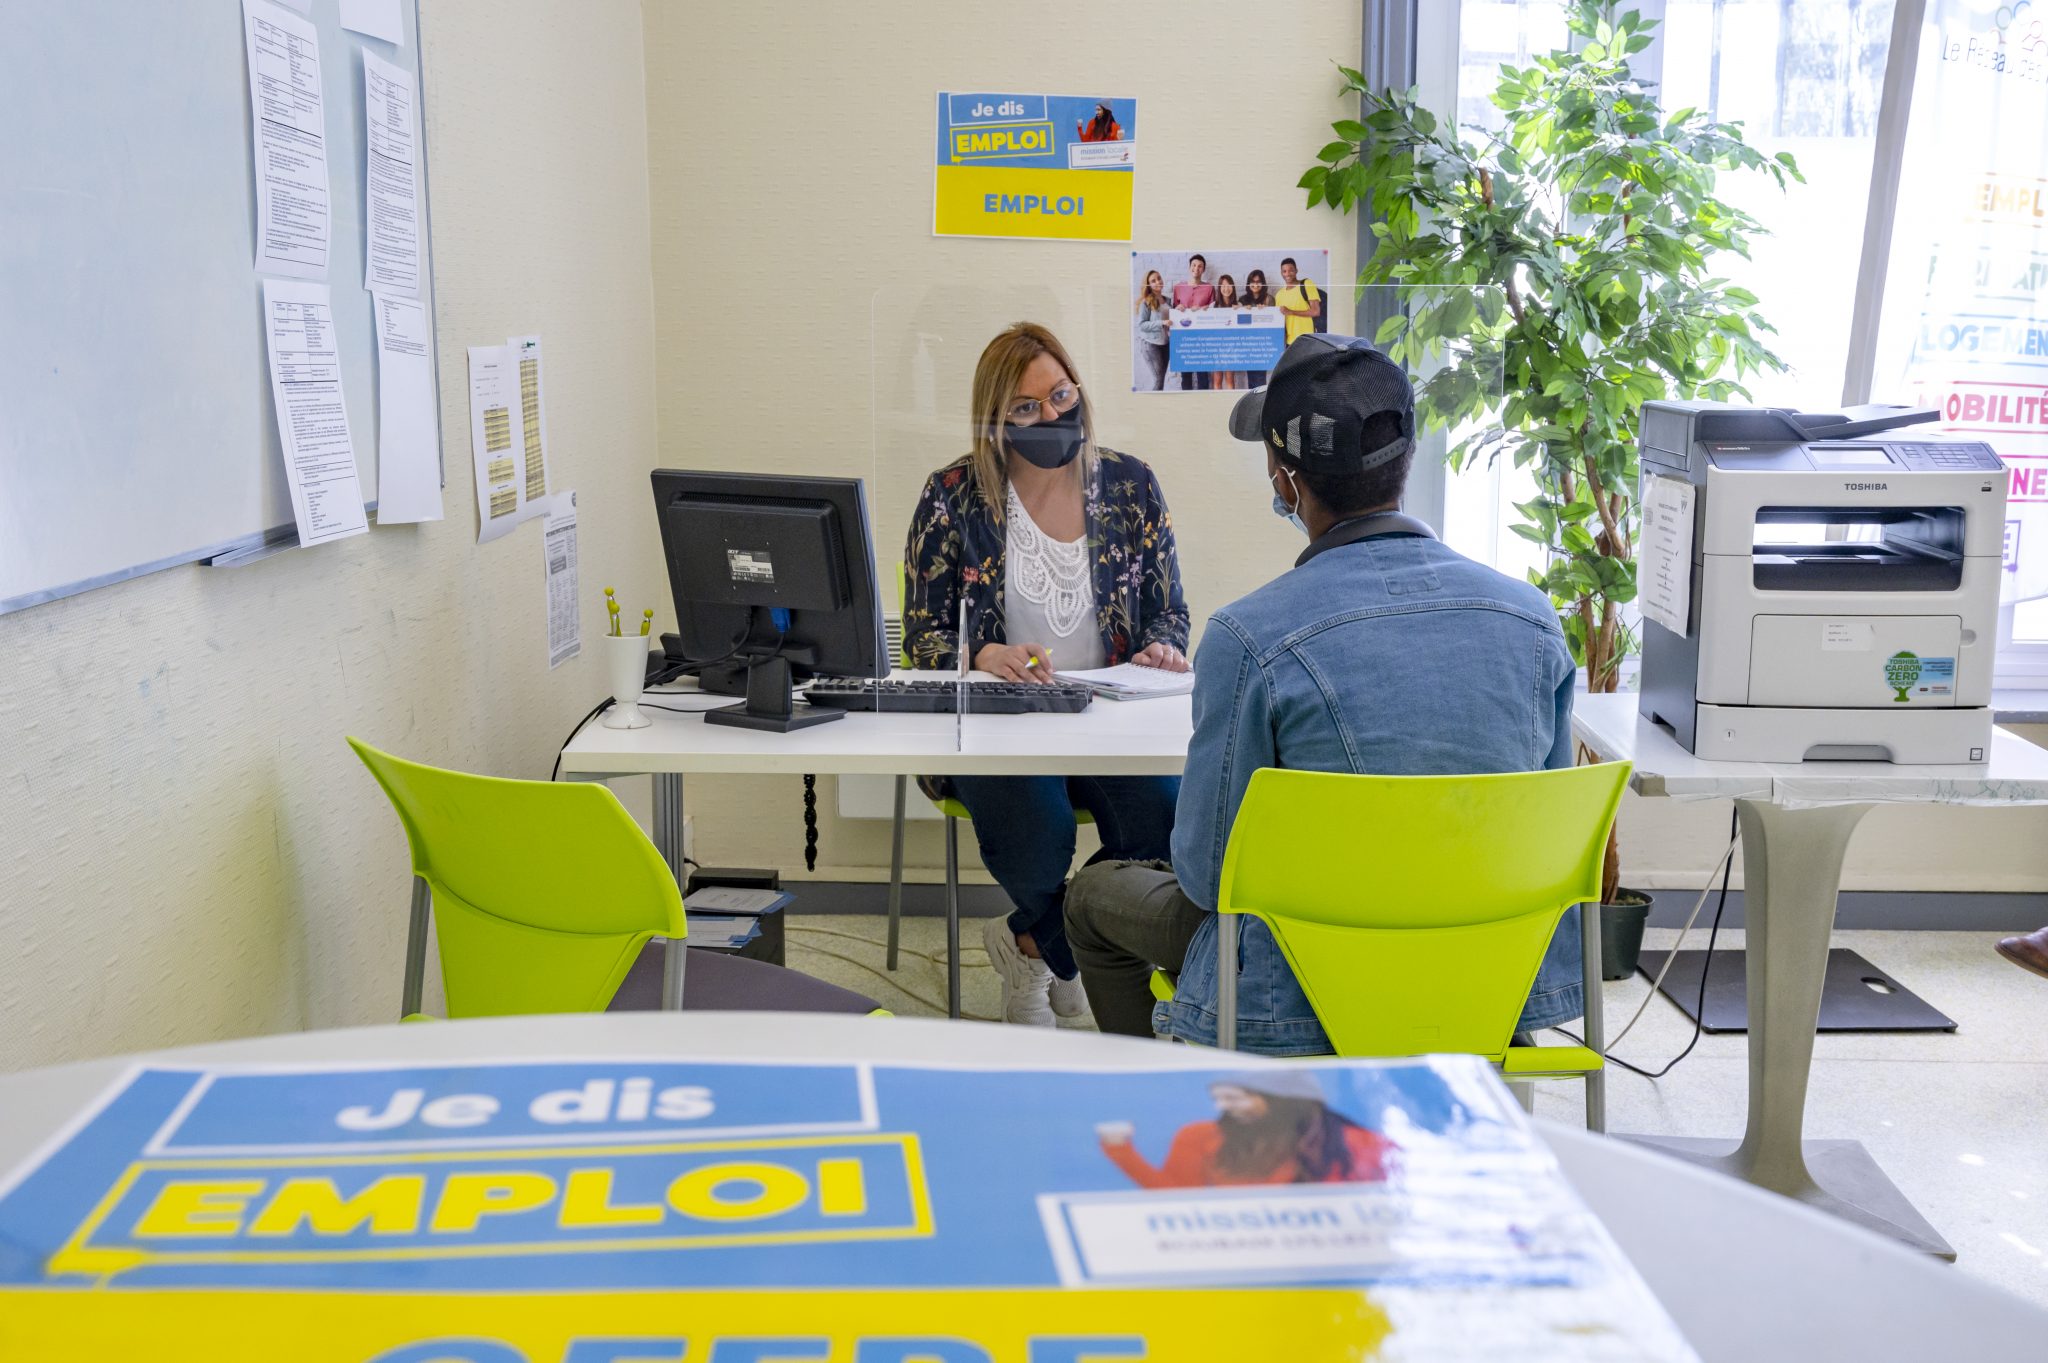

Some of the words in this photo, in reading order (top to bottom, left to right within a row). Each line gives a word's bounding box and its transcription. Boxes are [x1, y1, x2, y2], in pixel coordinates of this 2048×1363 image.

[971, 102, 993, 118] Je
[997, 100, 1024, 116] dis
[956, 130, 1046, 154] EMPLOI
[984, 193, 1083, 215] EMPLOI
[1977, 183, 2048, 218] EMPL
[1843, 482, 1888, 491] TOSHIBA
[1887, 672, 1919, 681] ZERO
[334, 1086, 501, 1132] Je
[528, 1077, 716, 1125] dis
[130, 1156, 868, 1239] EMPLOI
[1146, 1203, 1342, 1233] mission
